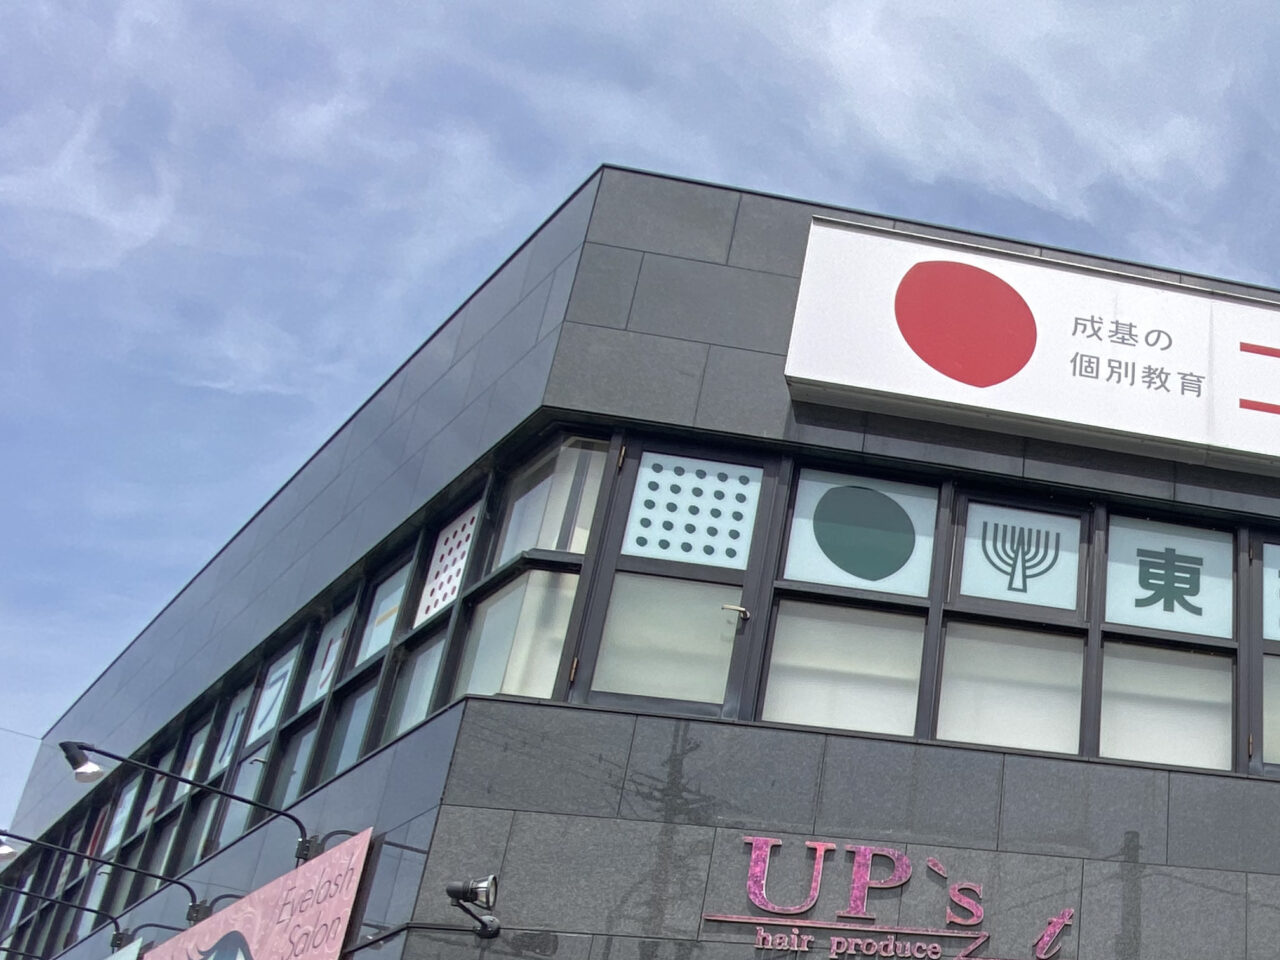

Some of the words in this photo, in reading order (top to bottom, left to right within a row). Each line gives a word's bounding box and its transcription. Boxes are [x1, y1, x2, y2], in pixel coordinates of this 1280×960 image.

[1070, 314, 1173, 352] 成基の
[1069, 351, 1206, 398] 個別教育
[276, 865, 355, 925] Eyelash
[754, 927, 815, 952] hair
[829, 934, 943, 960] produce
